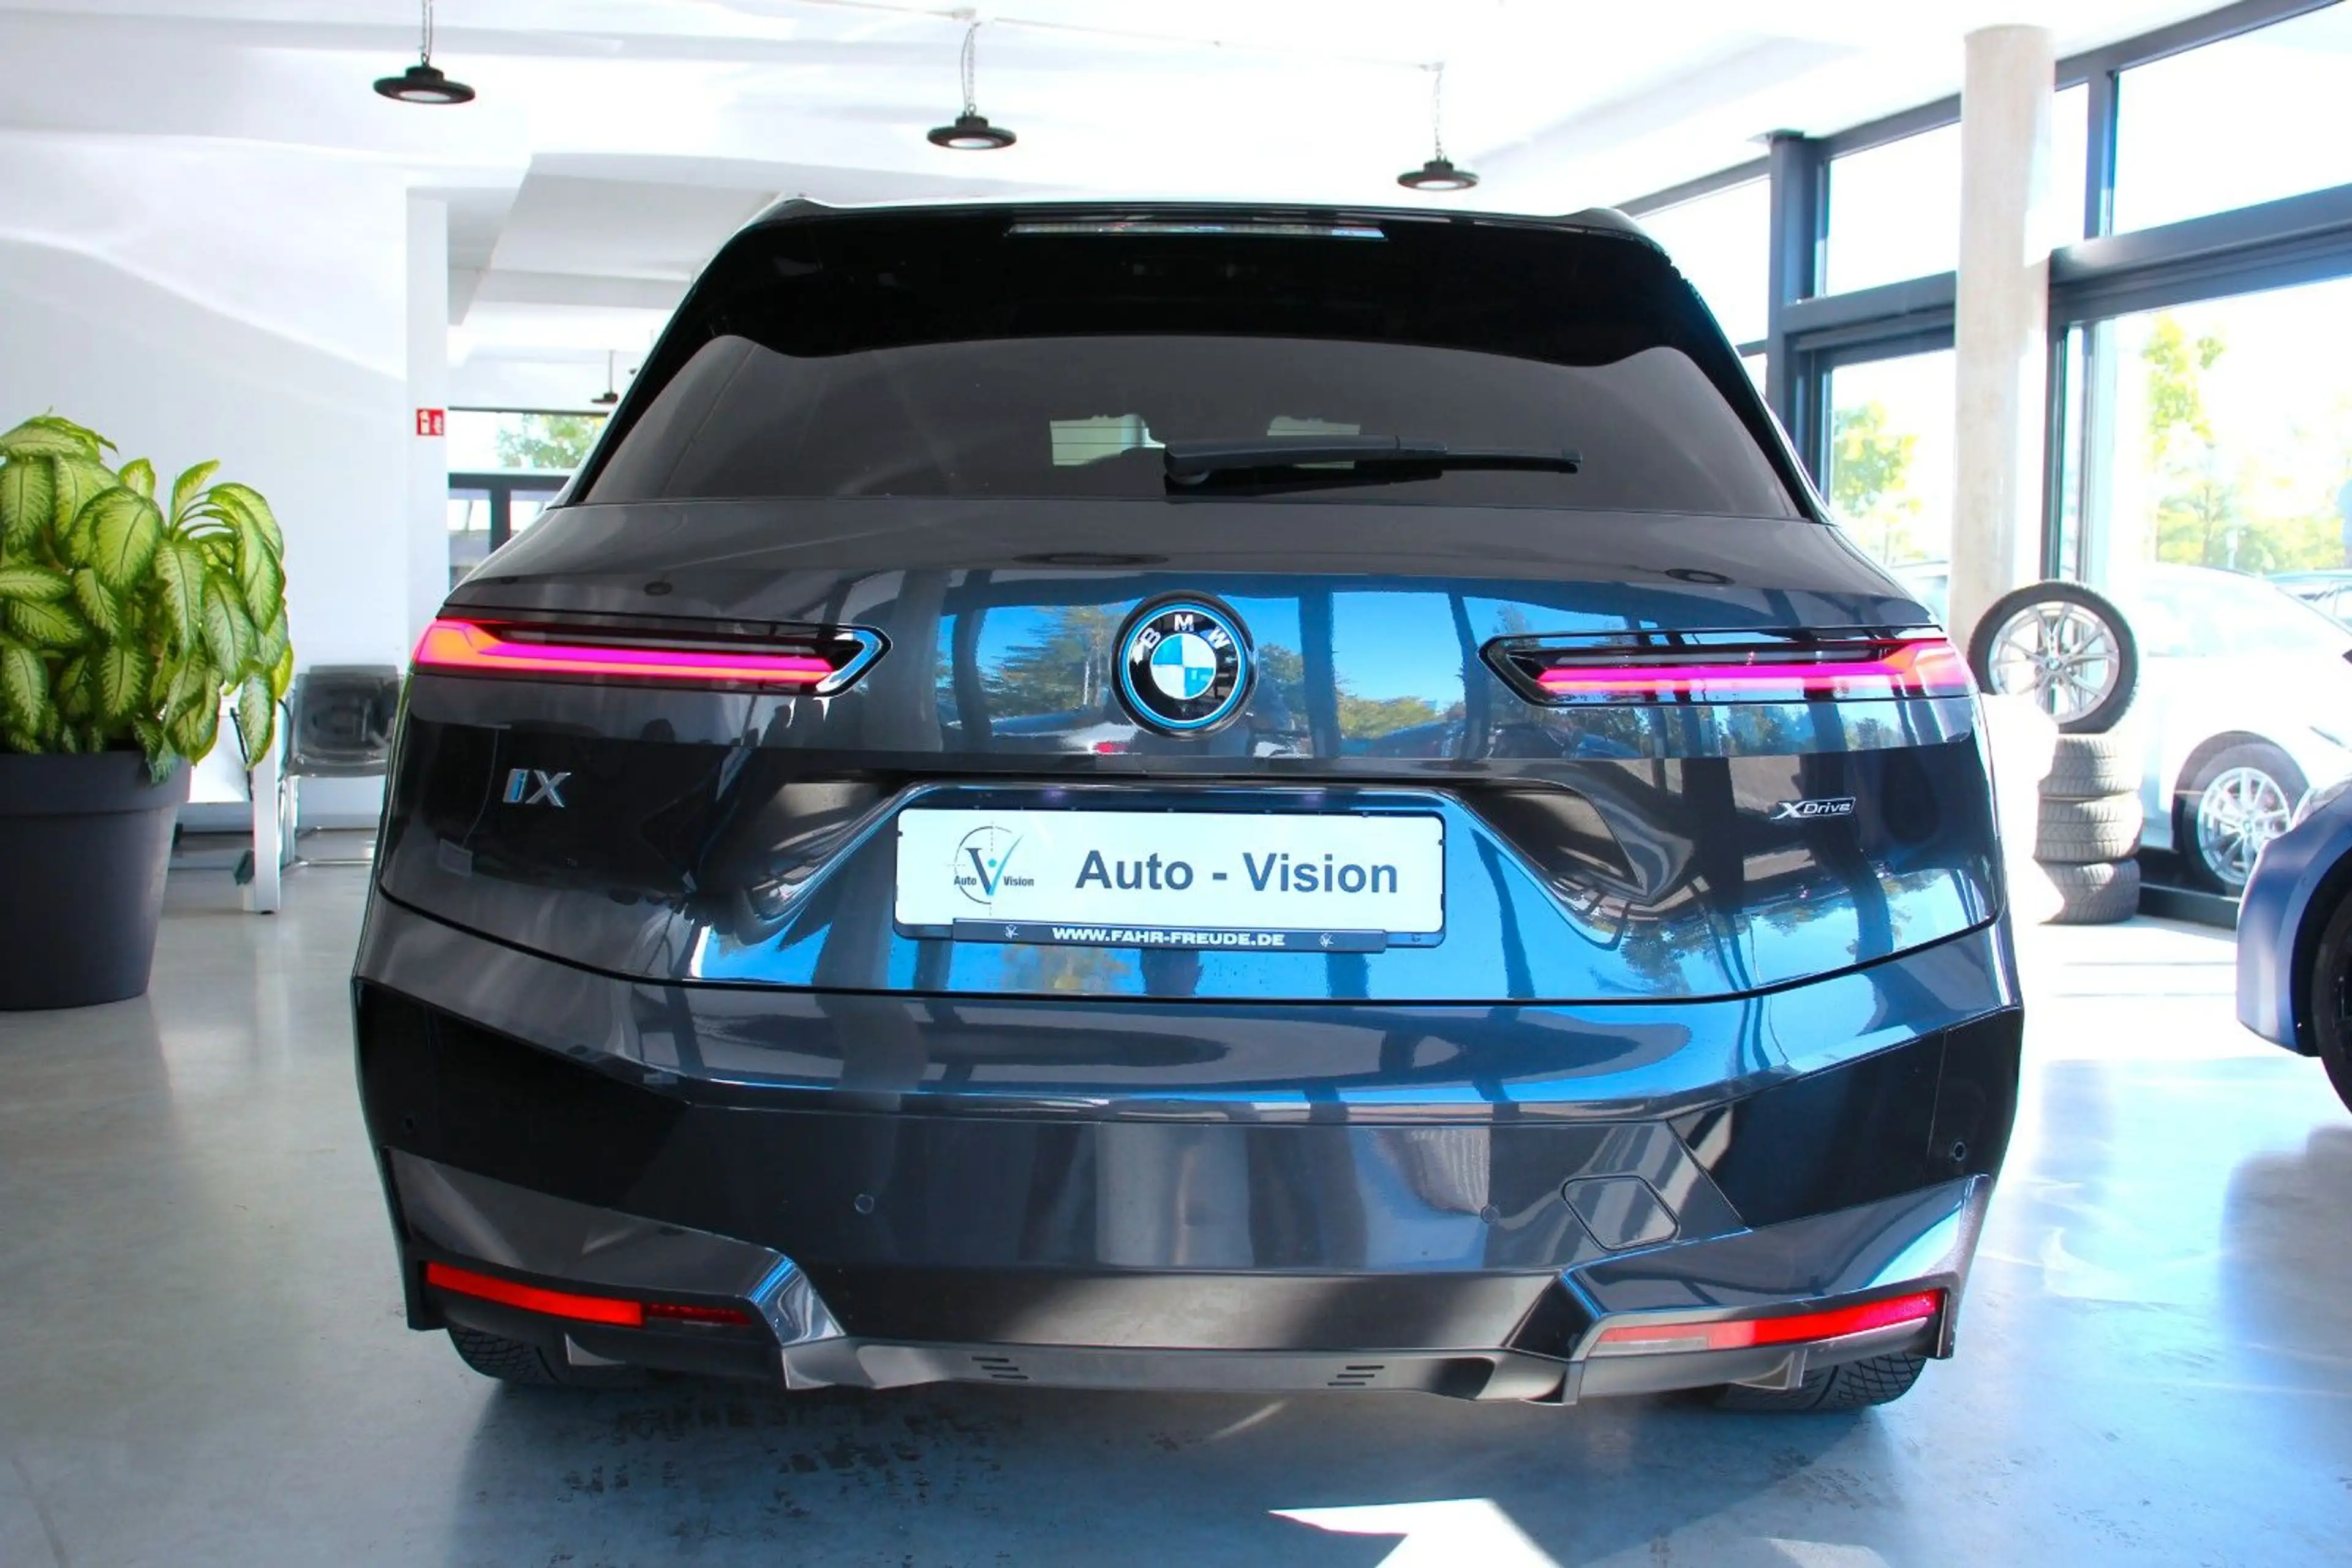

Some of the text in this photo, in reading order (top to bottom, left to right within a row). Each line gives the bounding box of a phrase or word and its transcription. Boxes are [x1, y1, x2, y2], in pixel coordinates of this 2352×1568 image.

[1139, 614, 1231, 649] BMW
[503, 769, 571, 807] iX
[954, 875, 1035, 886] Auto Vision
[1075, 850, 1193, 890] Auto
[1242, 852, 1398, 893] Vision
[1052, 927, 1285, 946] WWW.FAHR-FREUDE.DE
